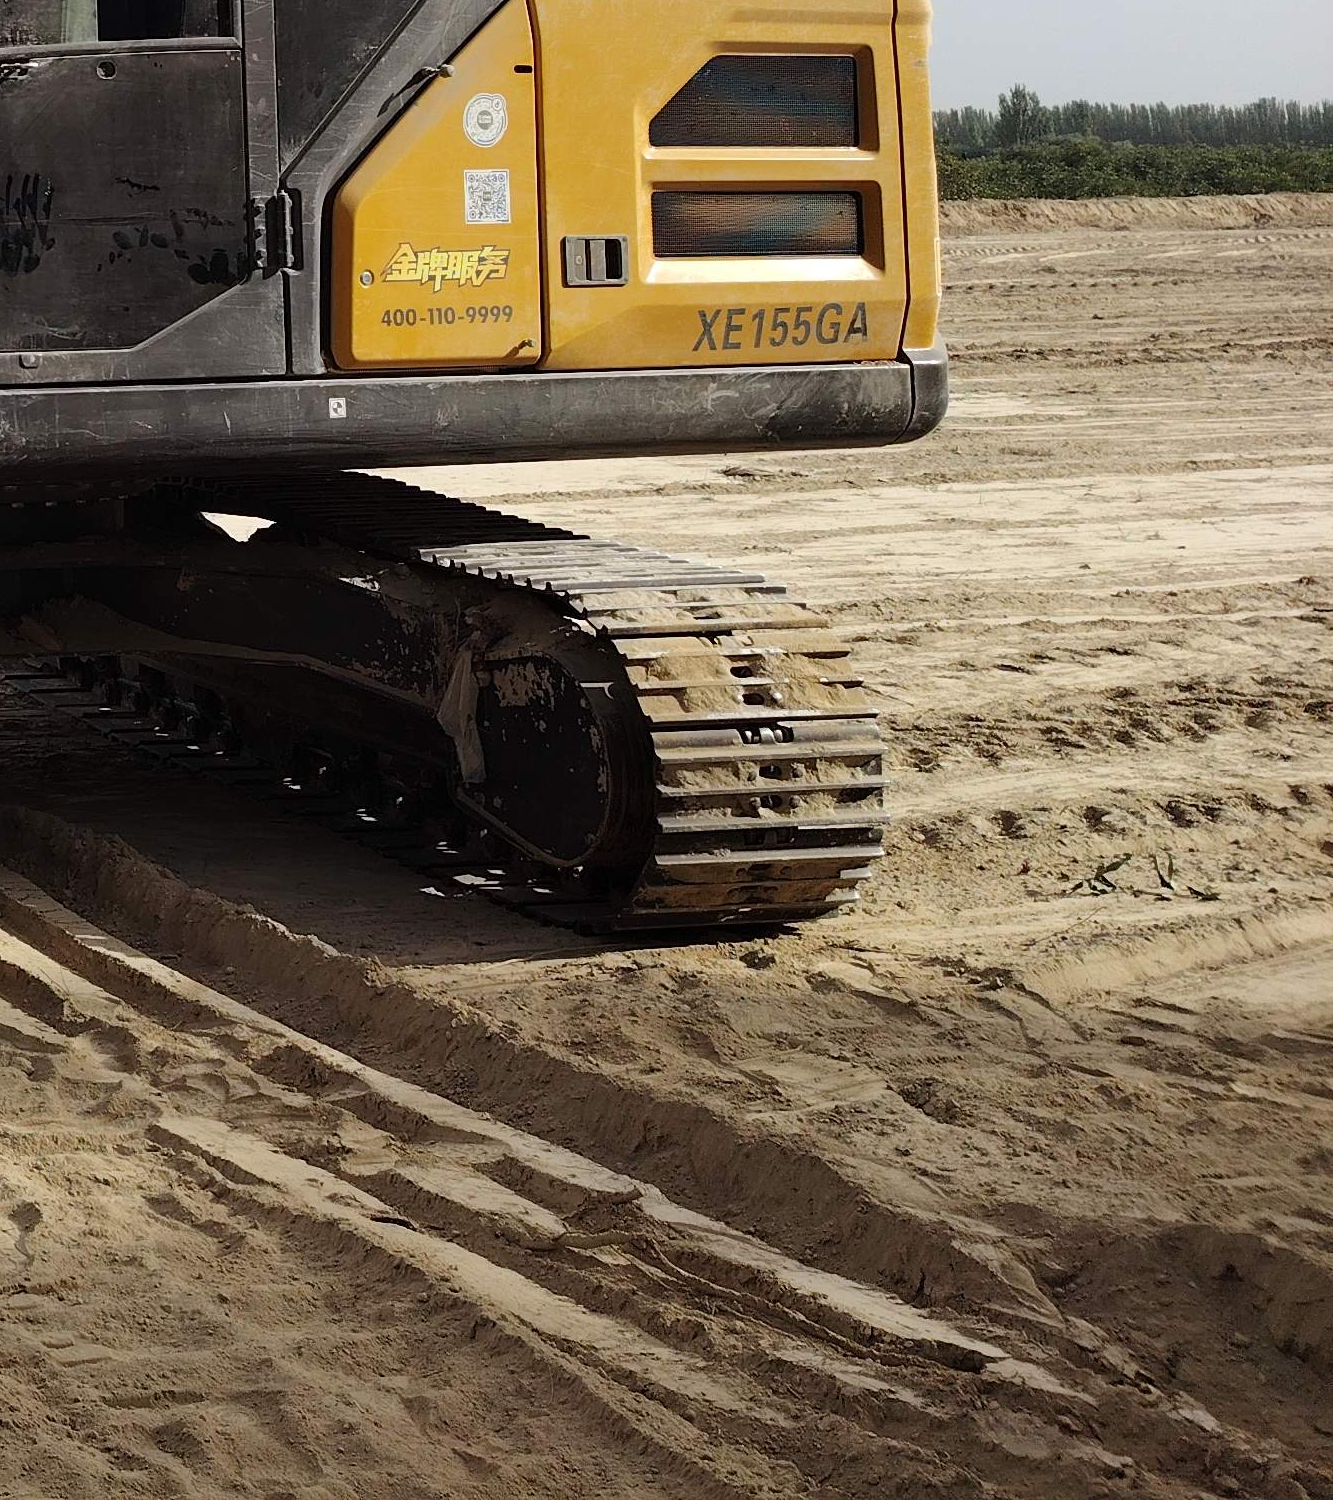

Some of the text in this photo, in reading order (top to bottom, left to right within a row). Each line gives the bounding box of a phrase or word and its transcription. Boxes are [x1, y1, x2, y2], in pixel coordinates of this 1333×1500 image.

[380, 243, 511, 293] 金牌服务
[381, 305, 513, 327] 400-110-9999
[692, 301, 869, 352] XE155GA
